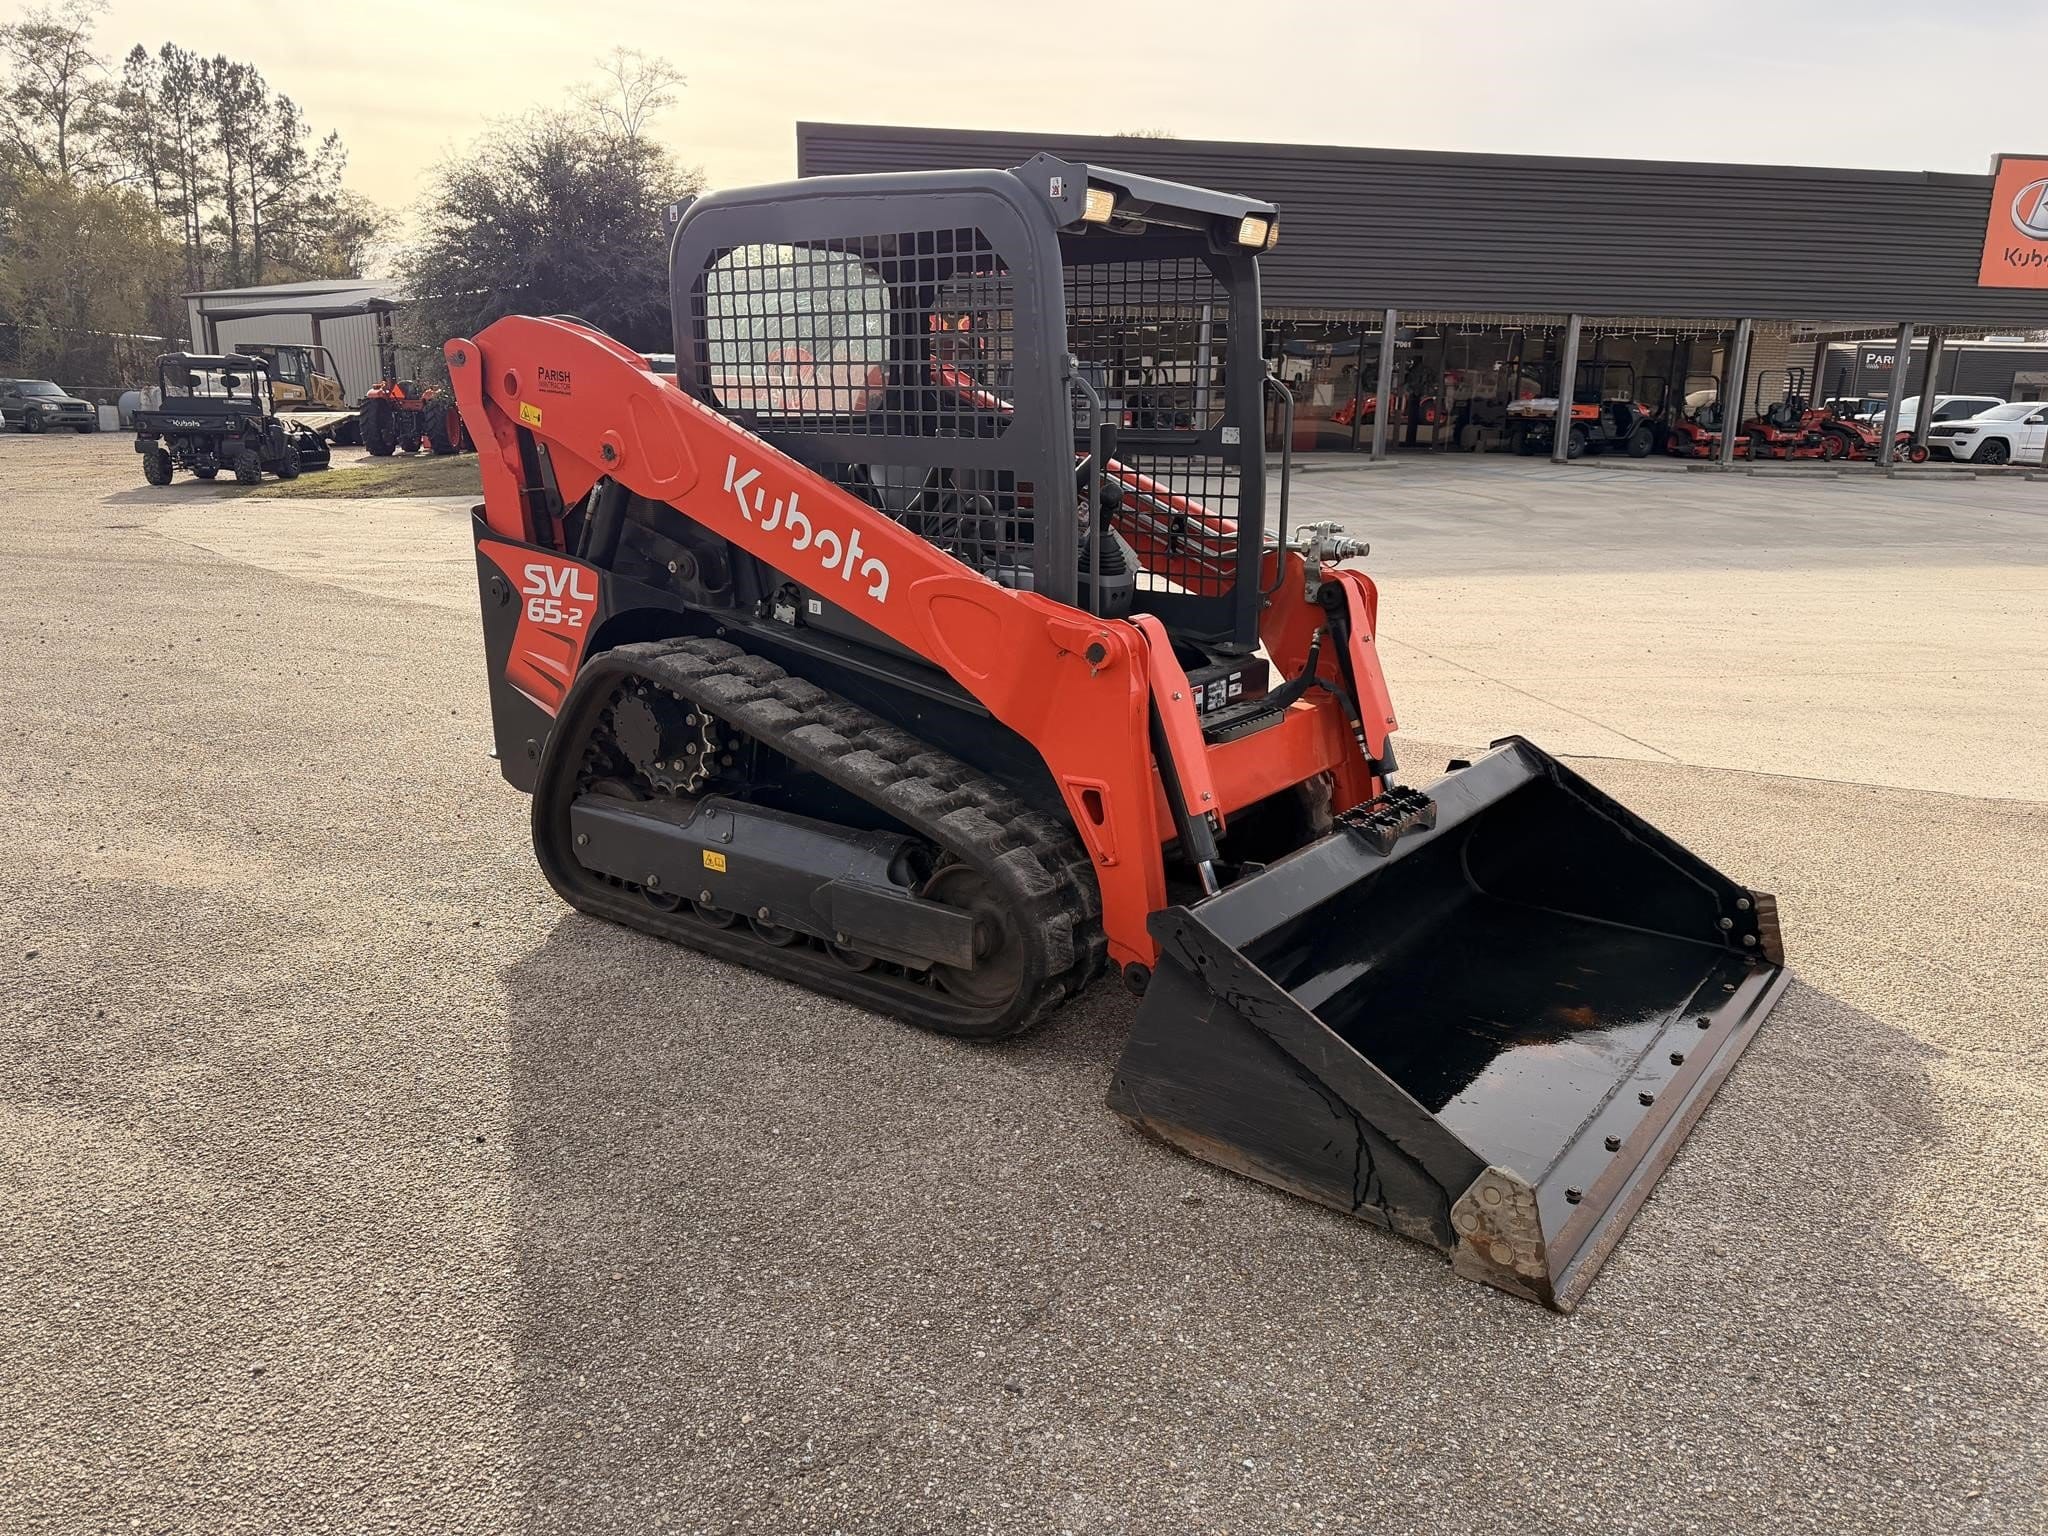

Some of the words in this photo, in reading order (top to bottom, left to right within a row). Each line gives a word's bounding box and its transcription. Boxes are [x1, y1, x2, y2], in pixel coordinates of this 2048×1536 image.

[1866, 353, 1911, 365] PARI
[538, 367, 571, 383] PARISH
[172, 419, 201, 427] Kubota
[723, 454, 890, 604] Kubota
[523, 564, 594, 601] SVL
[527, 597, 583, 627] 65-2
